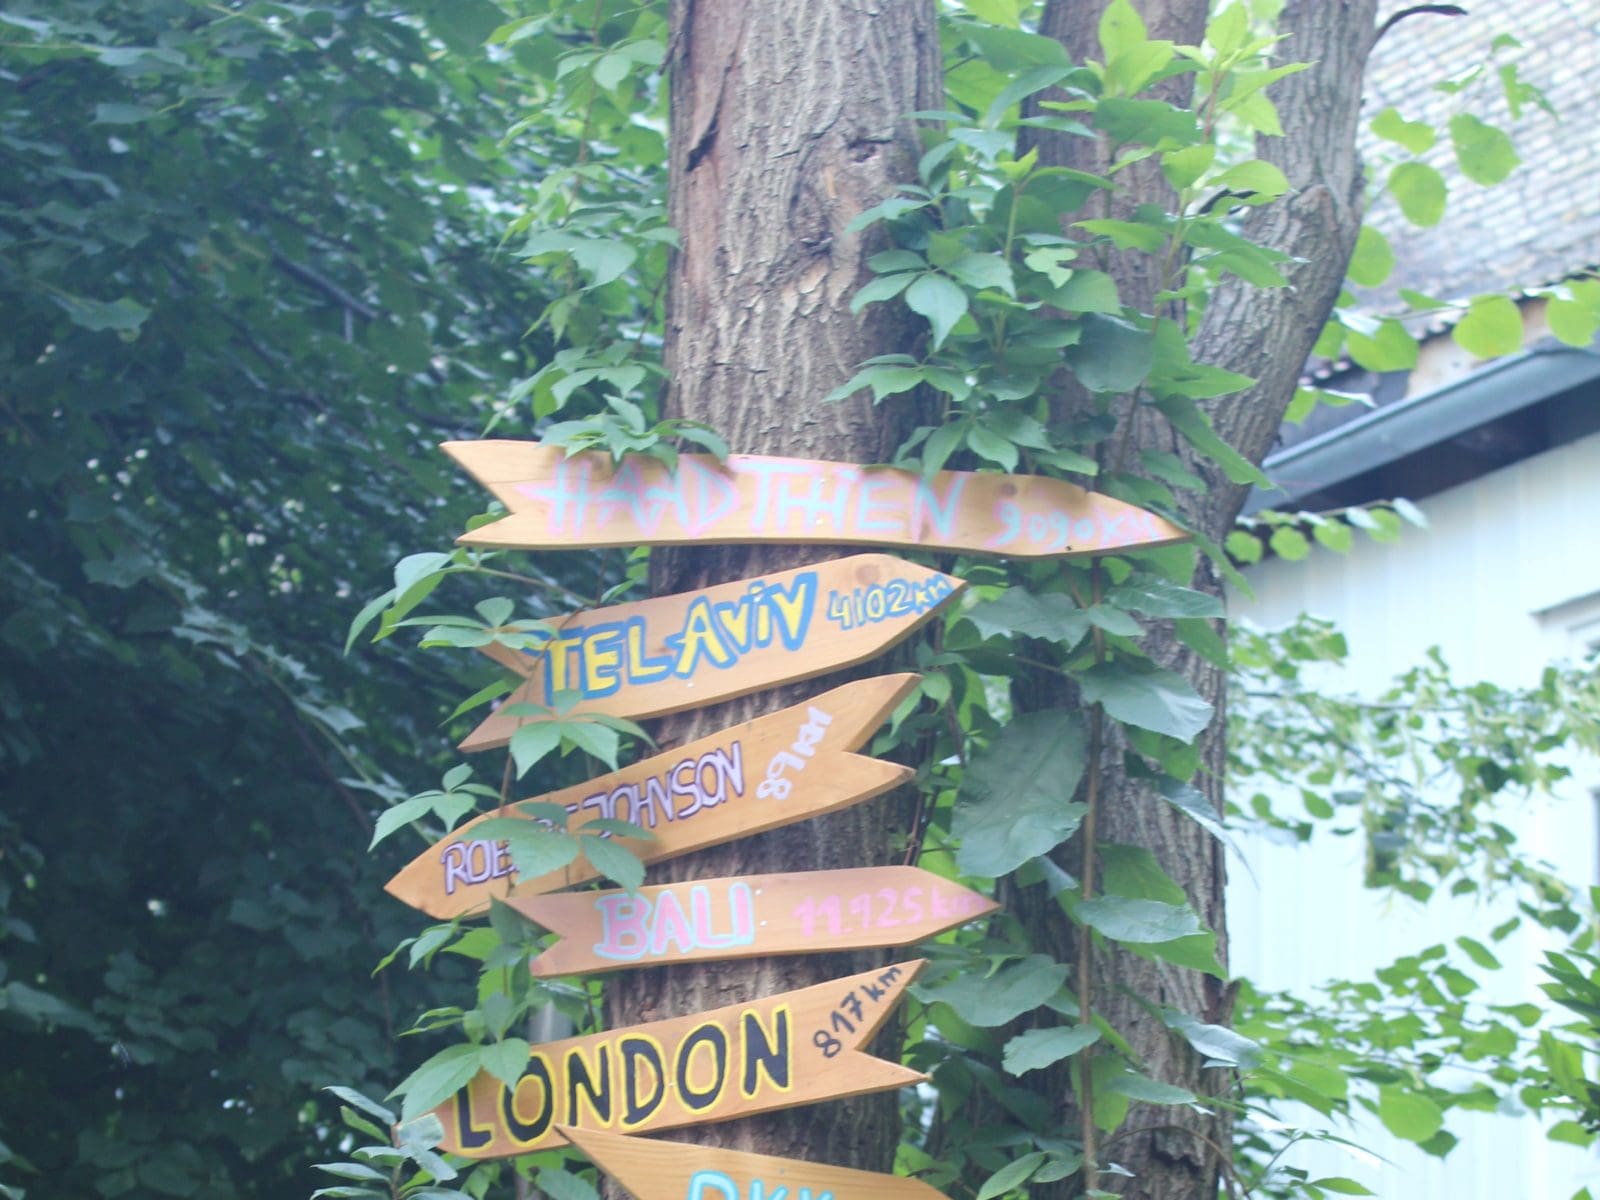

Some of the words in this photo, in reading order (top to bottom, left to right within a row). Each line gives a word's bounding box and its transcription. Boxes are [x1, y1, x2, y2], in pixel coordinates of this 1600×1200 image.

[520, 615, 672, 705] TEL
[583, 740, 745, 840] JOHNSON
[593, 882, 757, 960] BALI
[452, 1003, 792, 1152] LONDON
[813, 992, 863, 1058] 817
[860, 966, 902, 1002] km
